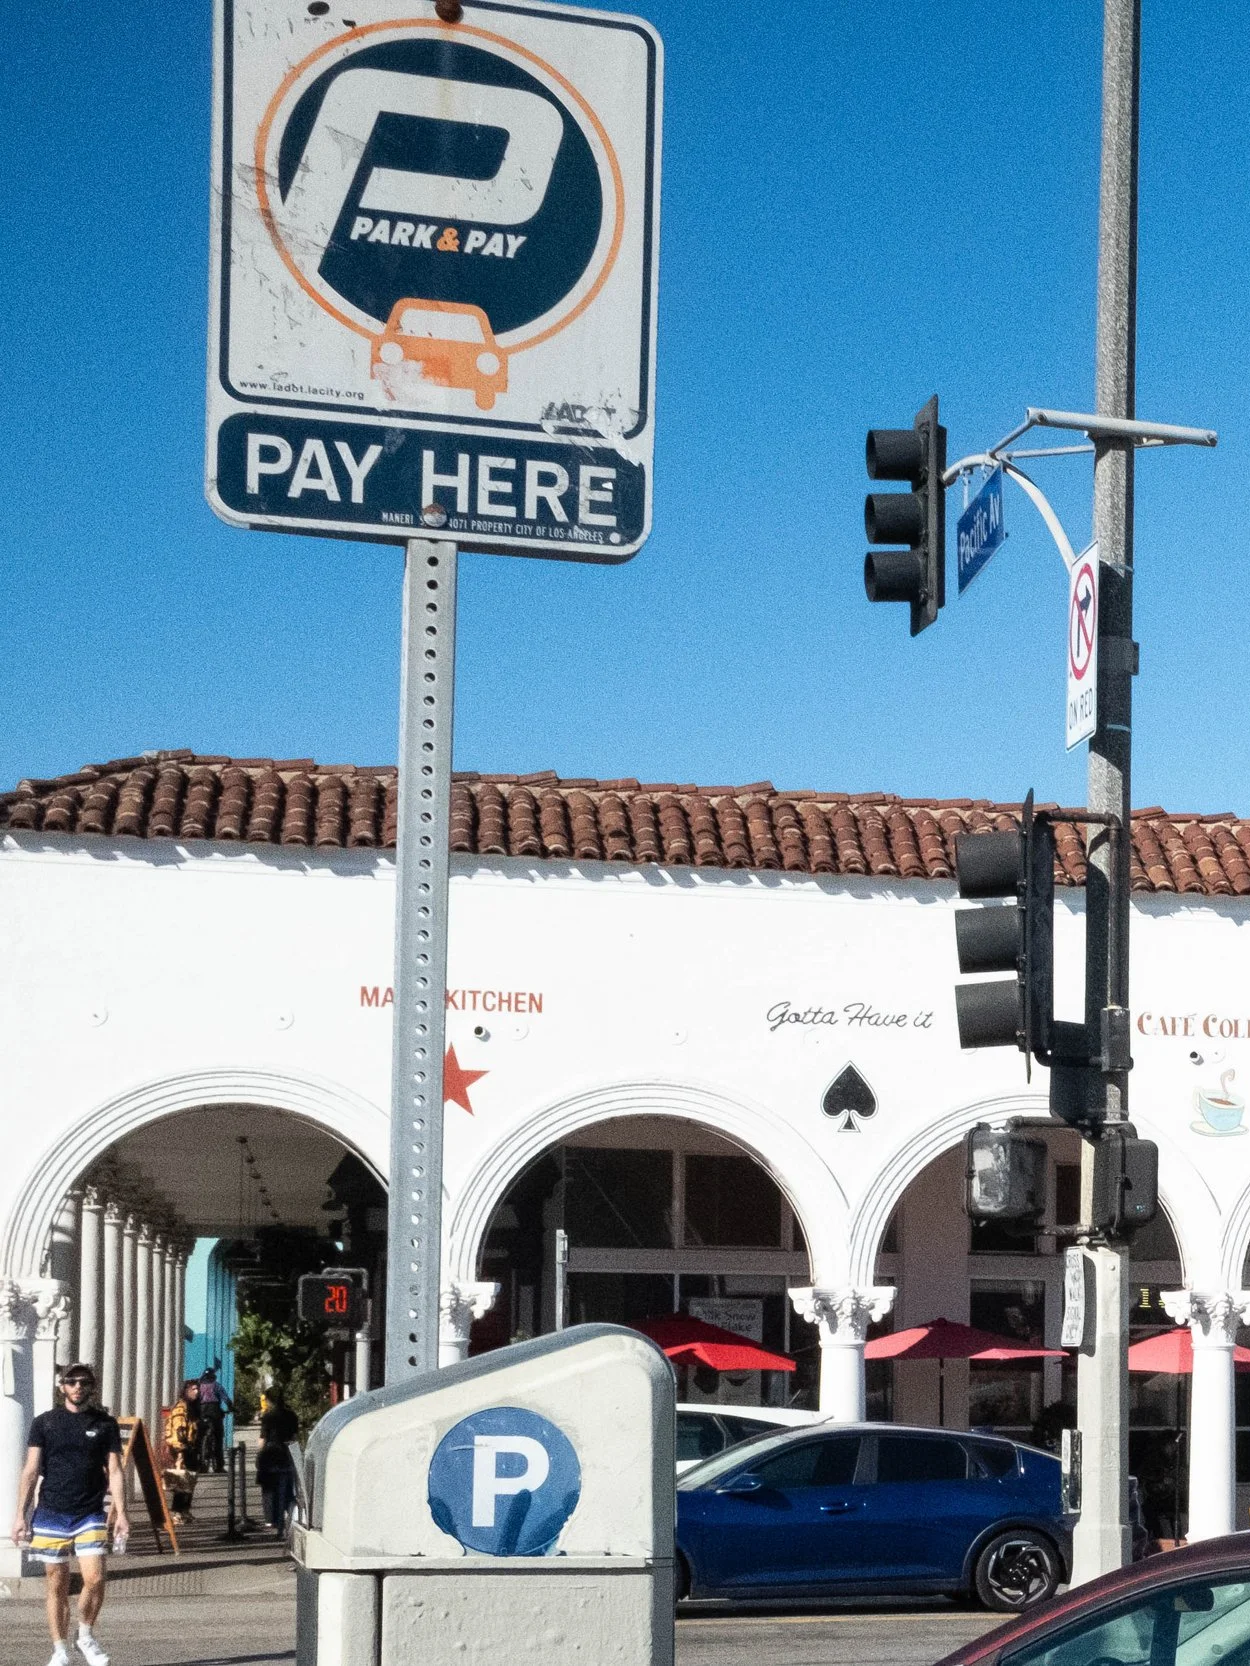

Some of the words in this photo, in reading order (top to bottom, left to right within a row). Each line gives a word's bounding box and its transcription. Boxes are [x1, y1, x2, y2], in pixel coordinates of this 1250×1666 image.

[350, 216, 433, 250] PARK
[436, 226, 459, 252] &
[463, 229, 527, 259] PAY
[245, 431, 384, 504] PAY
[420, 449, 618, 528] HERE
[471, 519, 513, 534] PROPERTY
[515, 524, 534, 536] CITY
[536, 525, 547, 537] OF
[549, 527, 565, 539] LOS
[960, 505, 988, 571] Pacific
[1080, 687, 1094, 721] RED
[446, 989, 543, 1014] KITCHEN
[766, 1001, 839, 1032] Gotta
[843, 1002, 908, 1027] Have
[913, 1011, 934, 1029] it
[325, 1285, 348, 1313] 20
[471, 1434, 550, 1528] P
